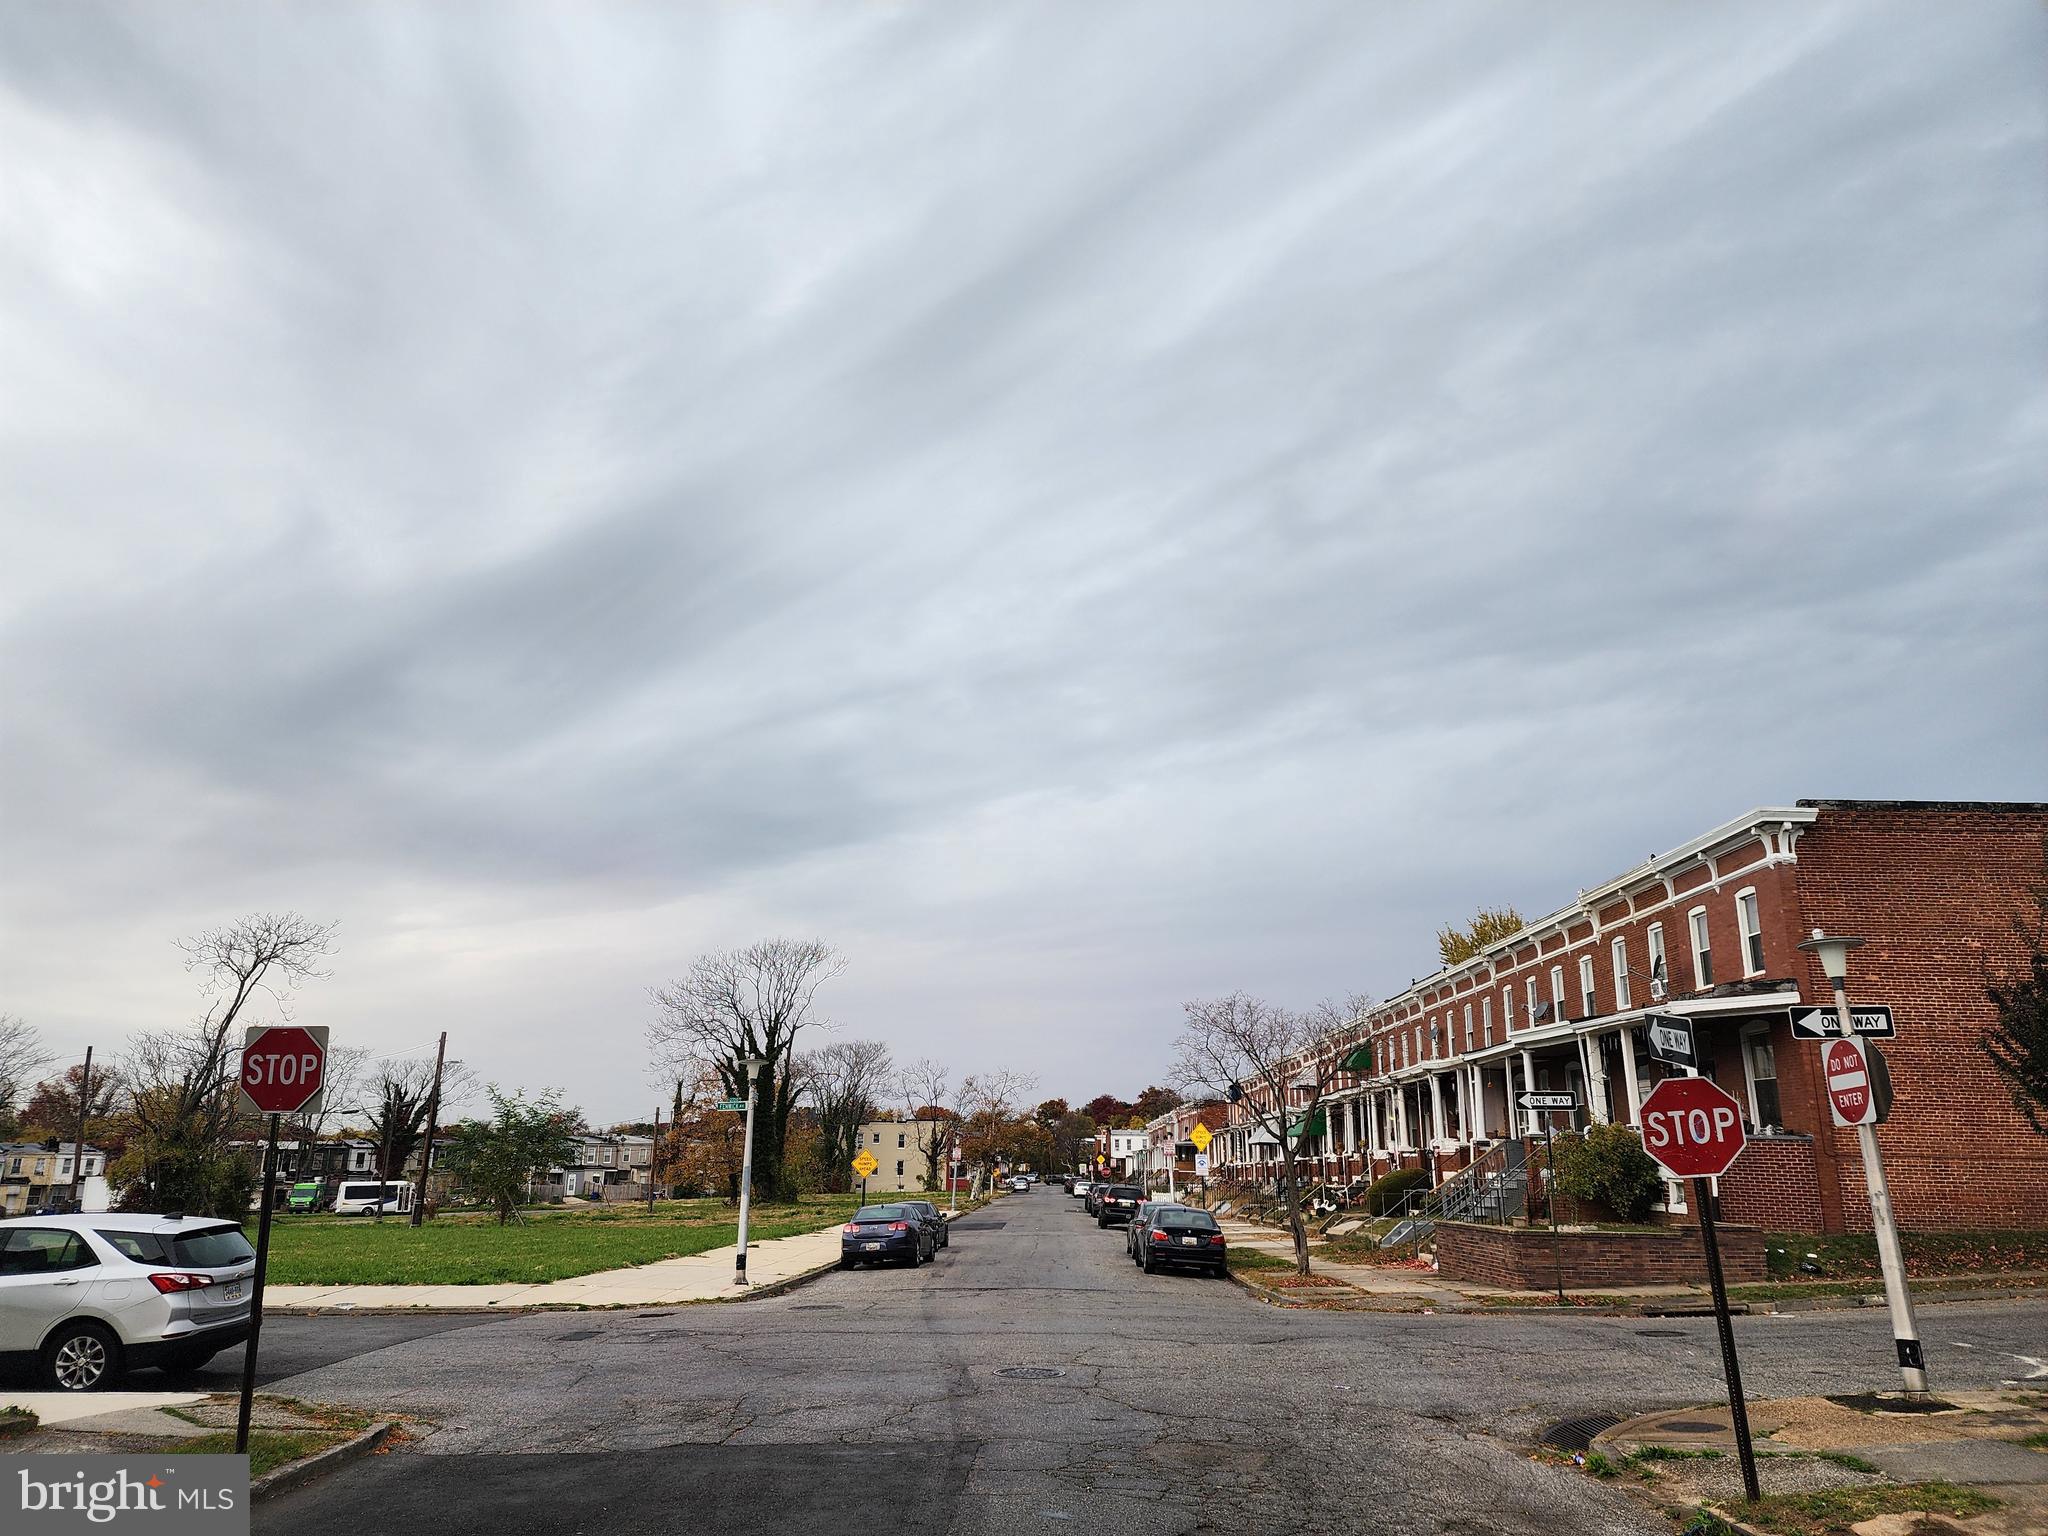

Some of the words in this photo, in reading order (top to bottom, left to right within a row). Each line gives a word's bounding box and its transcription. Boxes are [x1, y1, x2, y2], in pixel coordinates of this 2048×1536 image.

[1821, 1015, 1840, 1029] ON
[1852, 1015, 1881, 1029] WAY
[1659, 1029, 1674, 1048] ONE
[1673, 1031, 1687, 1051] WAY
[246, 1053, 318, 1085] STOP
[1829, 1058, 1841, 1072] DO
[1844, 1054, 1858, 1069] NOT
[1529, 1097, 1548, 1105] ONE
[1551, 1097, 1570, 1105] WAY
[1838, 1091, 1864, 1108] ENTER
[1647, 1107, 1735, 1147] STOP
